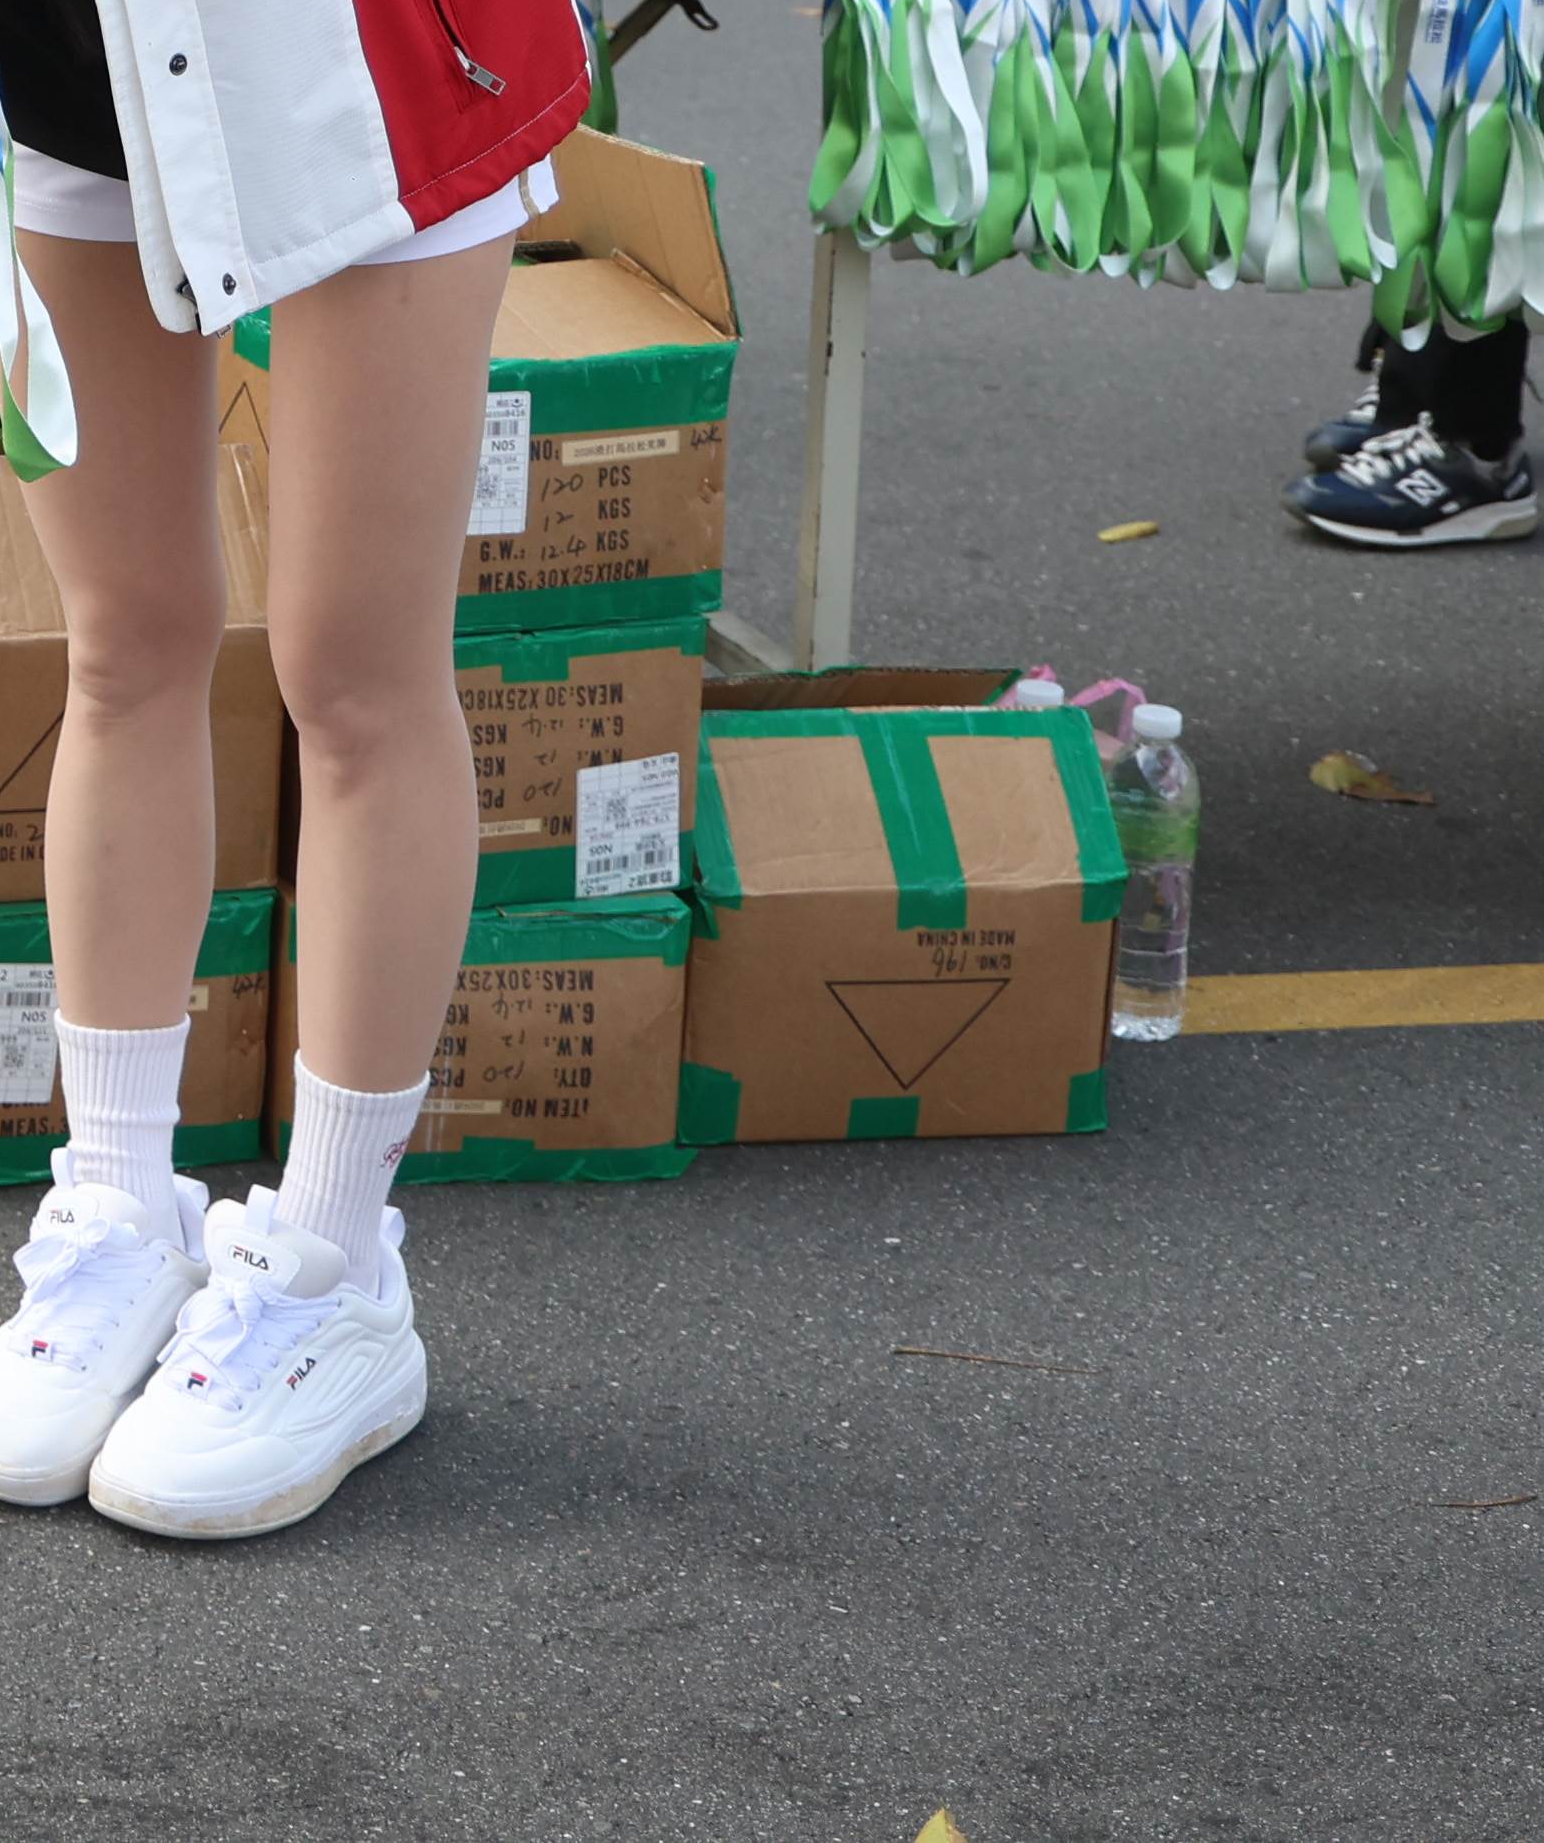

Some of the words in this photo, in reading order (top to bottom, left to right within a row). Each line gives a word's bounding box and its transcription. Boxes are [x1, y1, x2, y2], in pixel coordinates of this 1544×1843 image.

[598, 465, 631, 488] PCS
[541, 473, 584, 501] 120
[598, 498, 631, 519] KGS
[544, 513, 574, 533] 12
[596, 531, 629, 552] KGS
[473, 724, 507, 745] KGS
[523, 778, 563, 802] 120
[21, 845, 34, 861] IN
[917, 930, 958, 947] CHINA
[961, 931, 975, 946] IN
[980, 930, 1015, 946] MADE
[21, 1011, 47, 1022] N05
[446, 1004, 469, 1023] KG
[501, 1029, 525, 1050] 12
[429, 1068, 465, 1088] PCS
[483, 1060, 524, 1082] 120
[544, 1097, 590, 1117] ITEM
[49, 1209, 76, 1225] FILA
[232, 1244, 271, 1271] FILA
[285, 1357, 318, 1391] FILA
